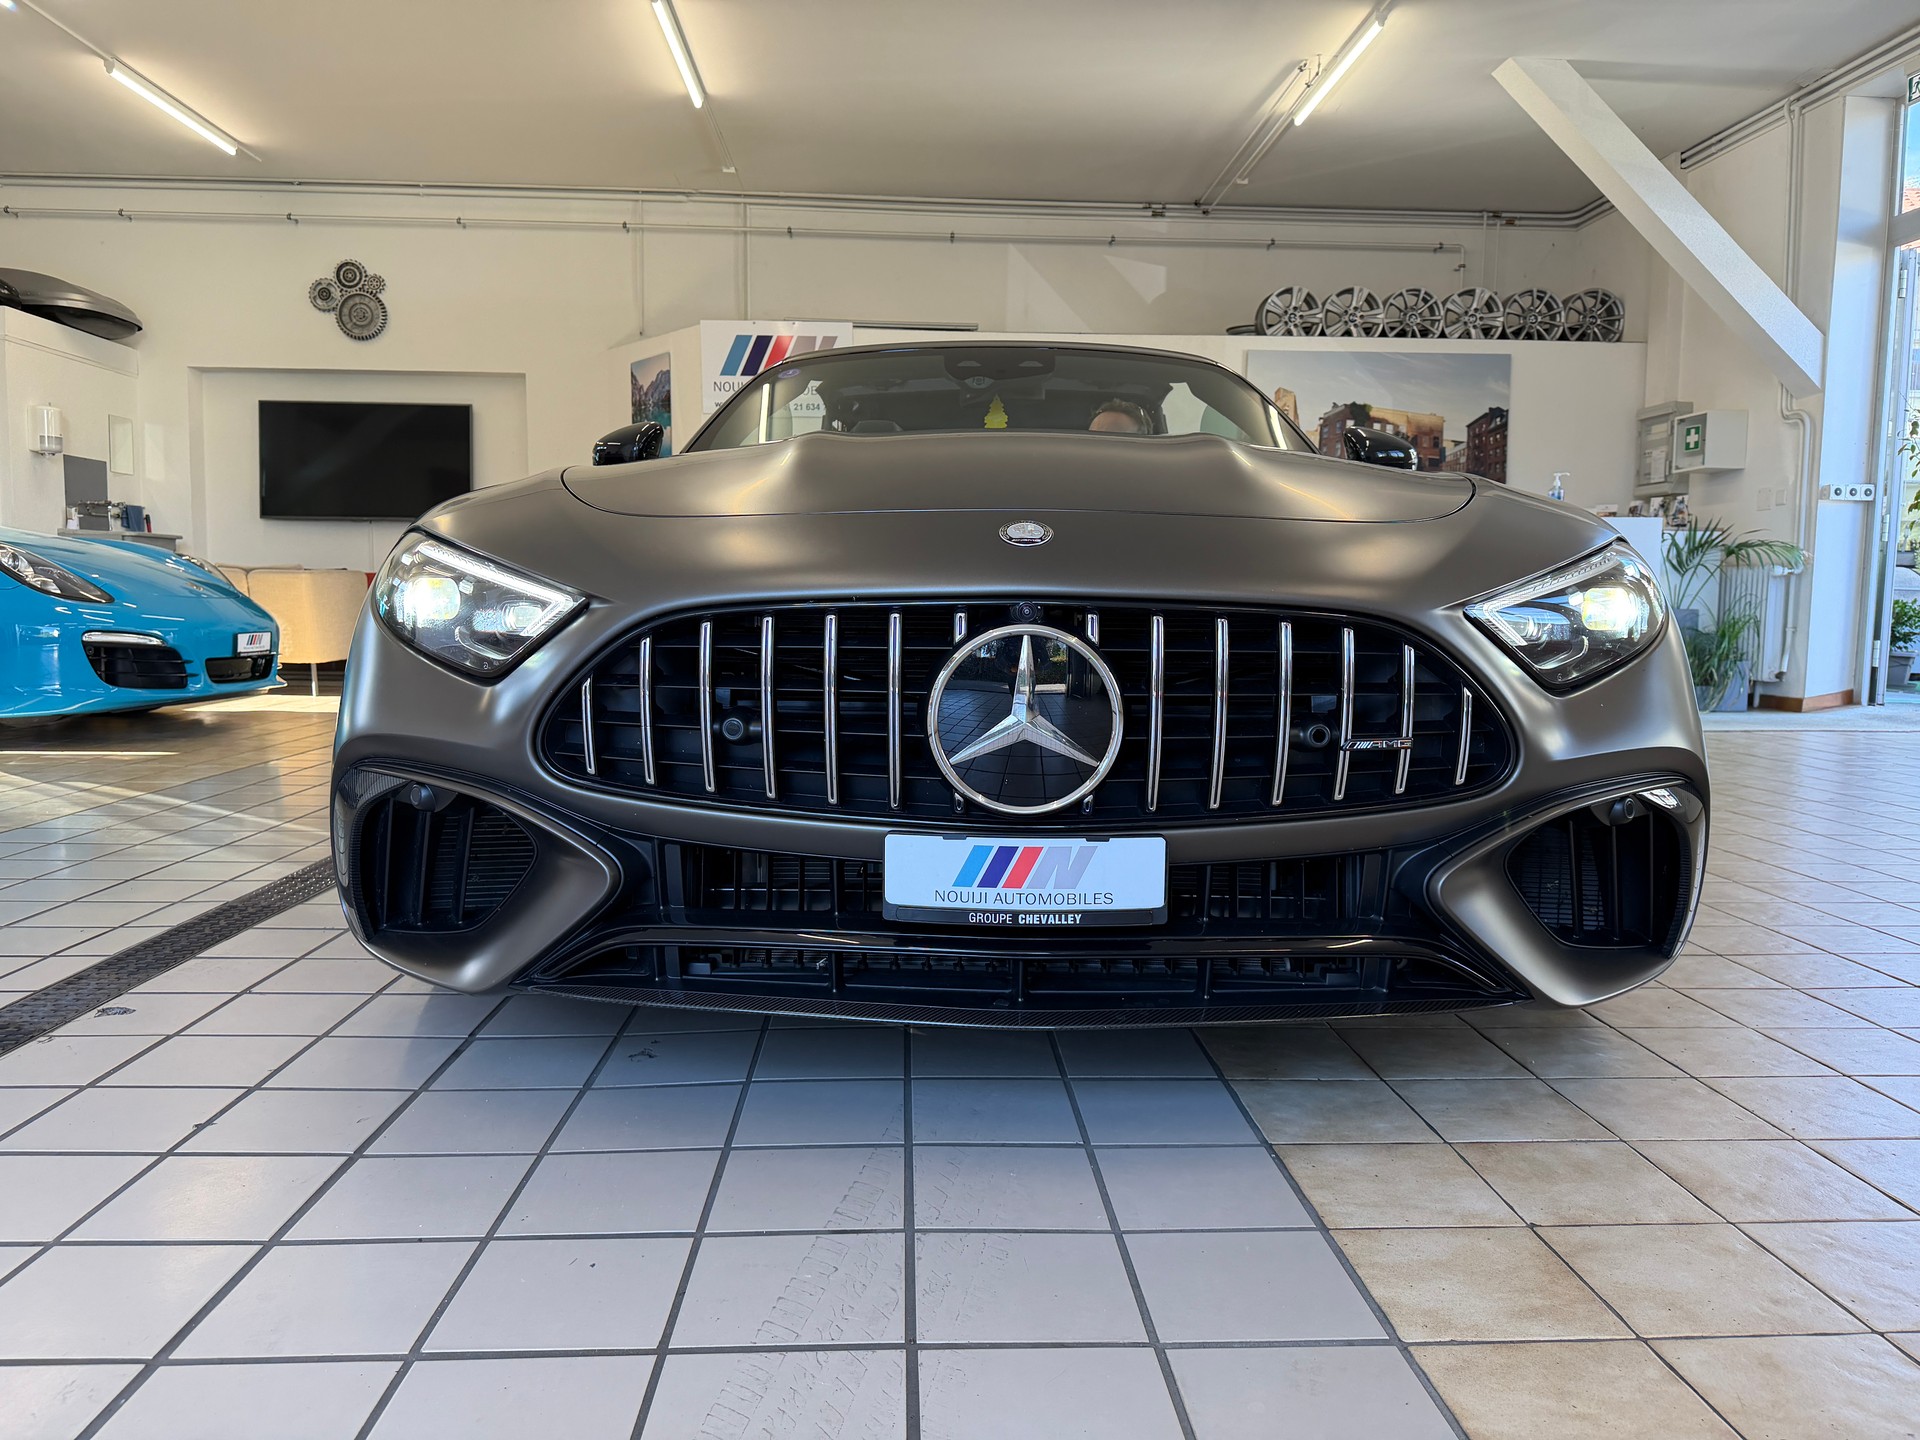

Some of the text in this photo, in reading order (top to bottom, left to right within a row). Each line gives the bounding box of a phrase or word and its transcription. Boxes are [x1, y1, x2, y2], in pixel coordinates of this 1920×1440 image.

[793, 402, 821, 411] 21 634
[934, 889, 1114, 905] NOUIJI AUTOMOBILES
[968, 912, 1082, 924] GROUPE CHEVALLEY
